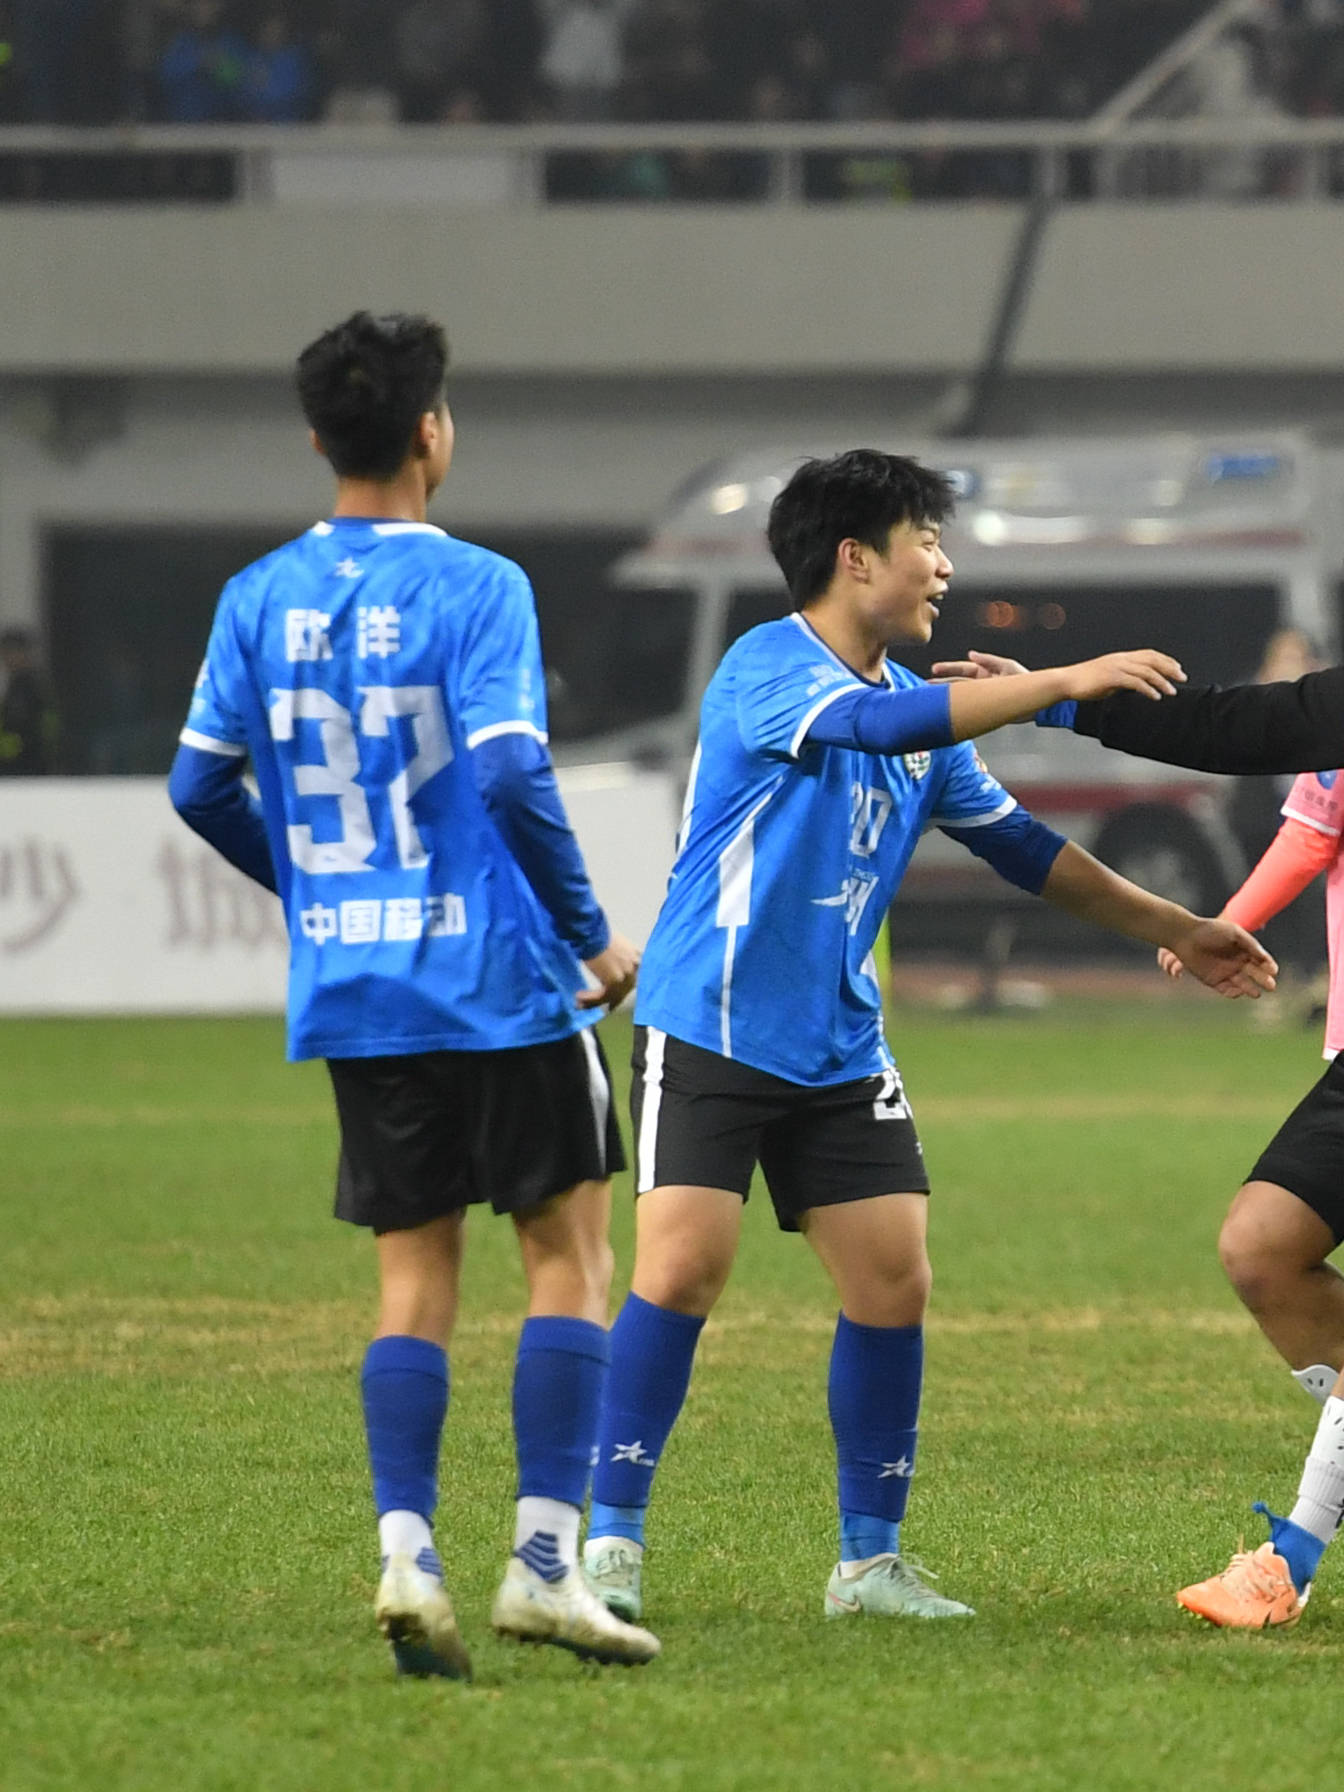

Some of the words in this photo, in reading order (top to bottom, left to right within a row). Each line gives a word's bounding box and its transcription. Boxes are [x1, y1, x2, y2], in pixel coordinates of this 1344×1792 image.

[286, 605, 401, 663] 欧洋
[268, 684, 456, 876] 37
[300, 892, 468, 946] 中国移动
